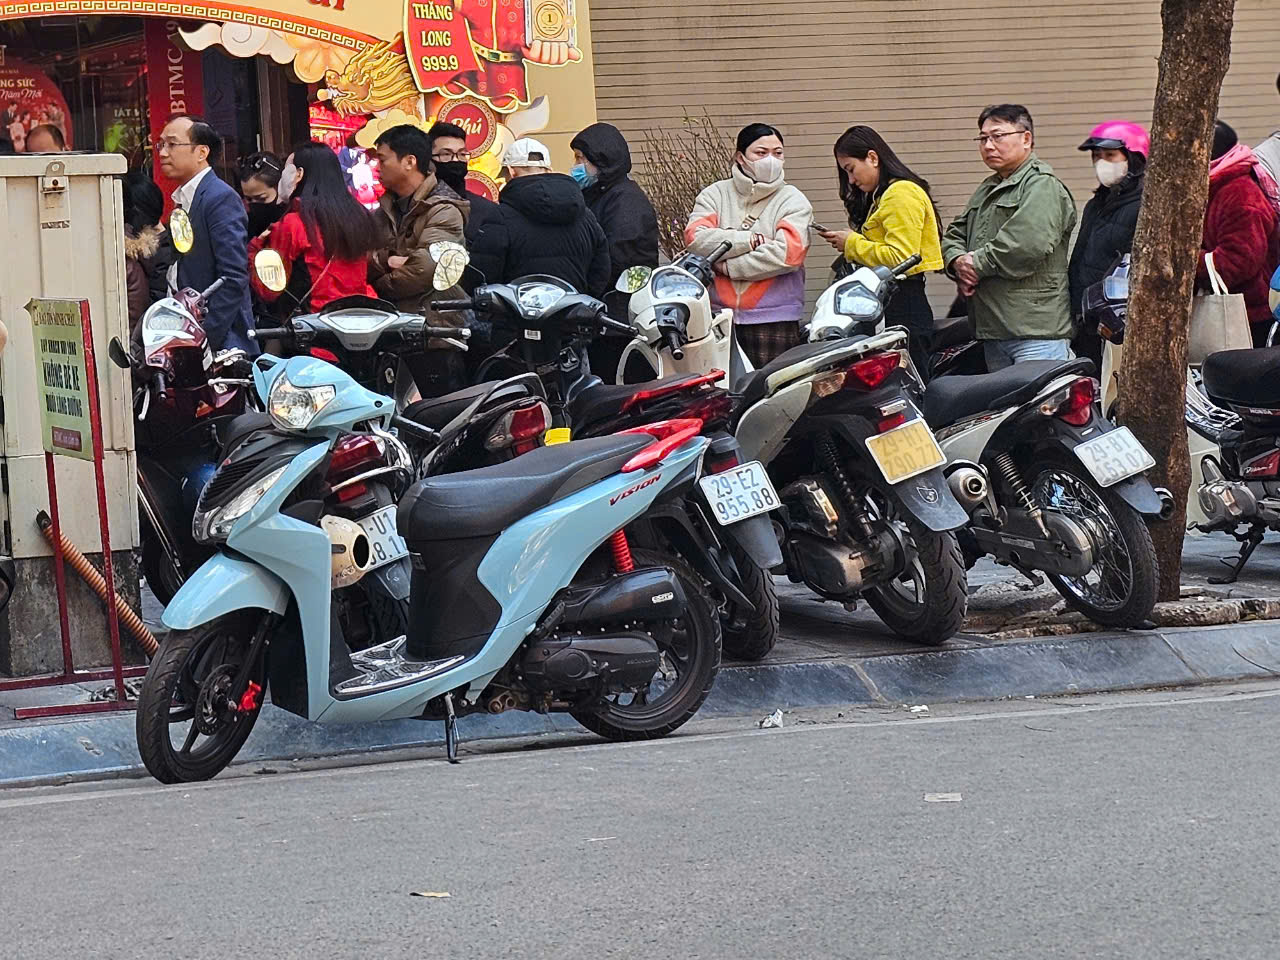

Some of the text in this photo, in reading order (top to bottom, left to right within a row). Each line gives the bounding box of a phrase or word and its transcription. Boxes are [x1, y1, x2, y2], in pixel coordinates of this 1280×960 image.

[412, 0, 454, 21] THĂNG
[421, 30, 452, 47] LONG
[421, 55, 459, 72] 999.9
[167, 48, 187, 114] BTMC
[609, 473, 662, 506] VISION
[710, 467, 760, 499] 29-E2
[716, 487, 774, 521] 955.88
